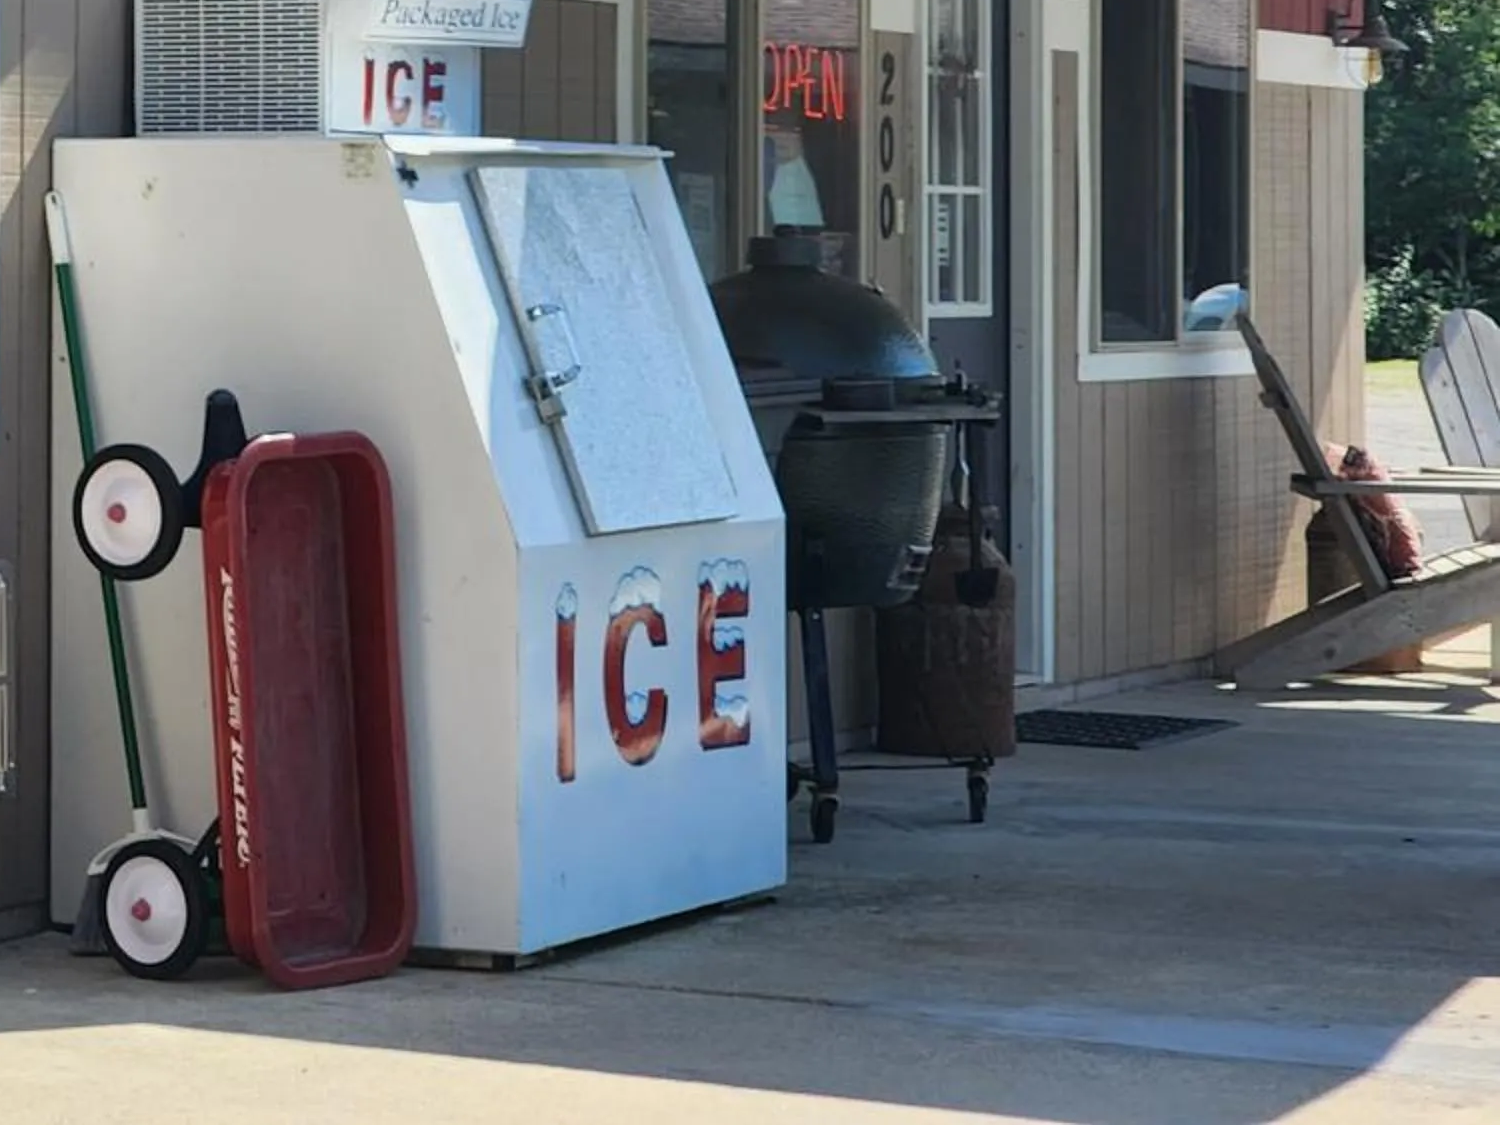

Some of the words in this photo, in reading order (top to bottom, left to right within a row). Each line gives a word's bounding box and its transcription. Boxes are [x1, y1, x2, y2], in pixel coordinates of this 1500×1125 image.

[490, 2, 520, 30] Ice
[362, 51, 447, 129] ICE
[763, 41, 845, 121] OPEN
[555, 557, 750, 783] ICE
